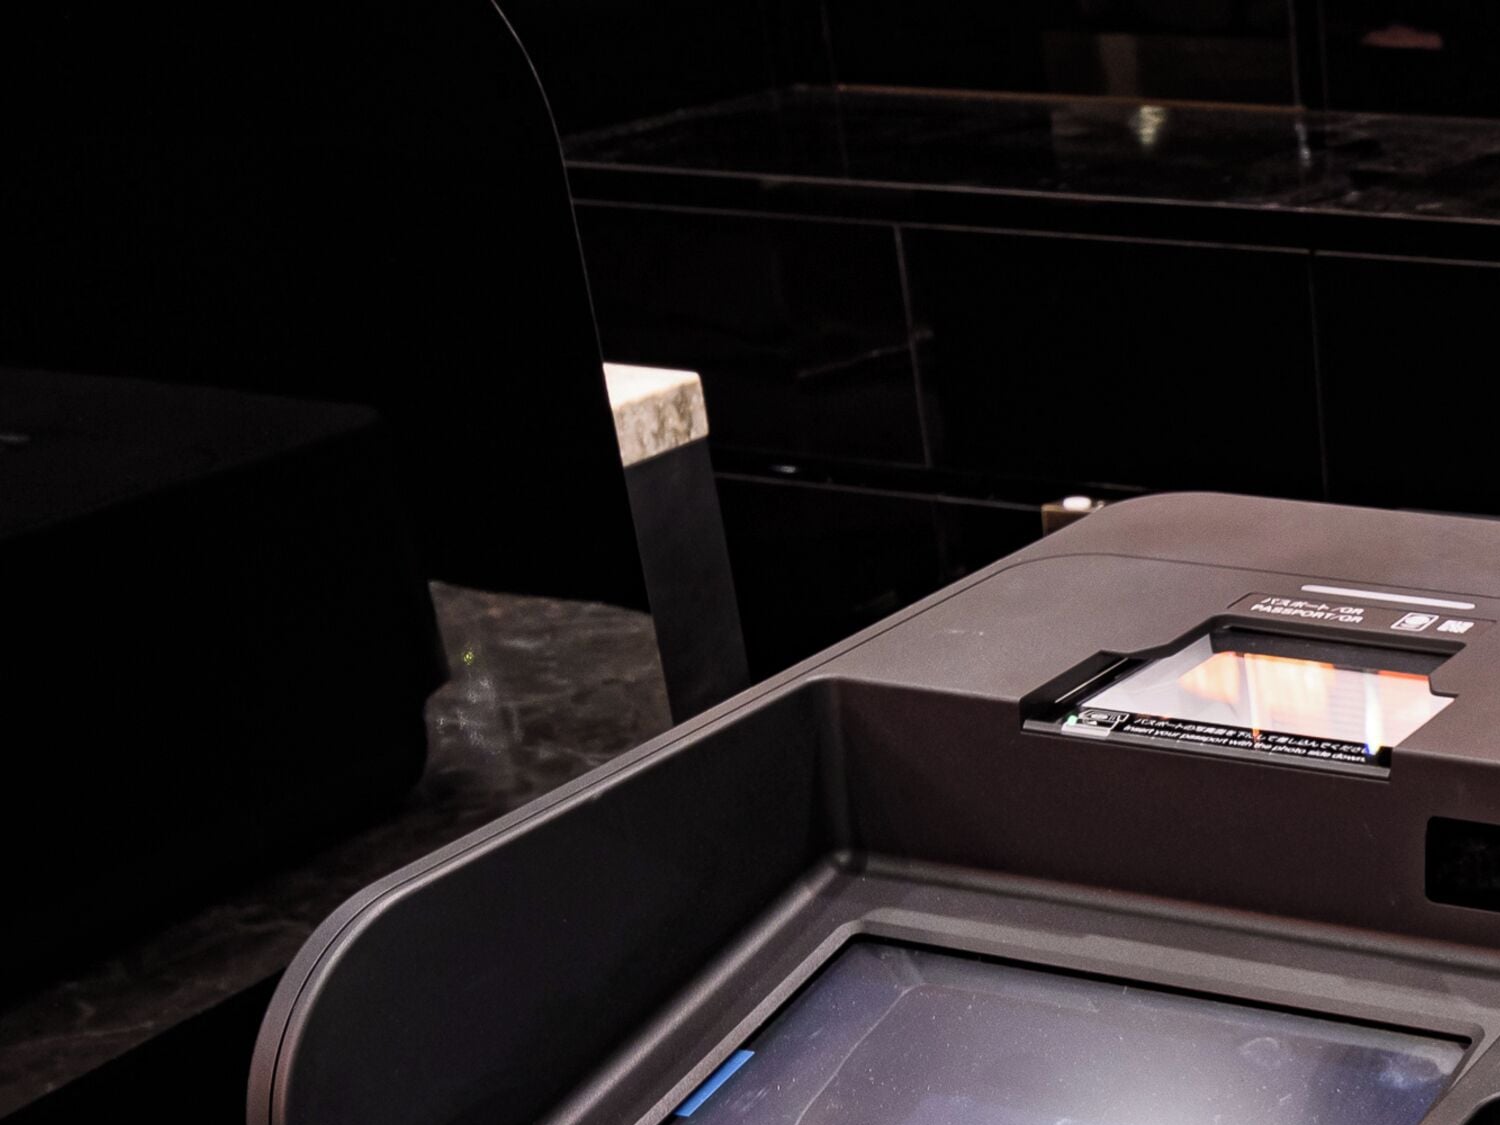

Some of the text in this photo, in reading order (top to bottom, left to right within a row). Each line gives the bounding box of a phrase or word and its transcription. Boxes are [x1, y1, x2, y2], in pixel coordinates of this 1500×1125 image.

[1250, 603, 1364, 624] PASSPORT/QR
[1123, 724, 1153, 735] Insert
[1154, 730, 1180, 741] your
[1179, 732, 1228, 746] passport
[1228, 739, 1253, 749] with
[1253, 742, 1273, 751] the
[1271, 745, 1306, 756] photo
[1307, 750, 1331, 759] side
